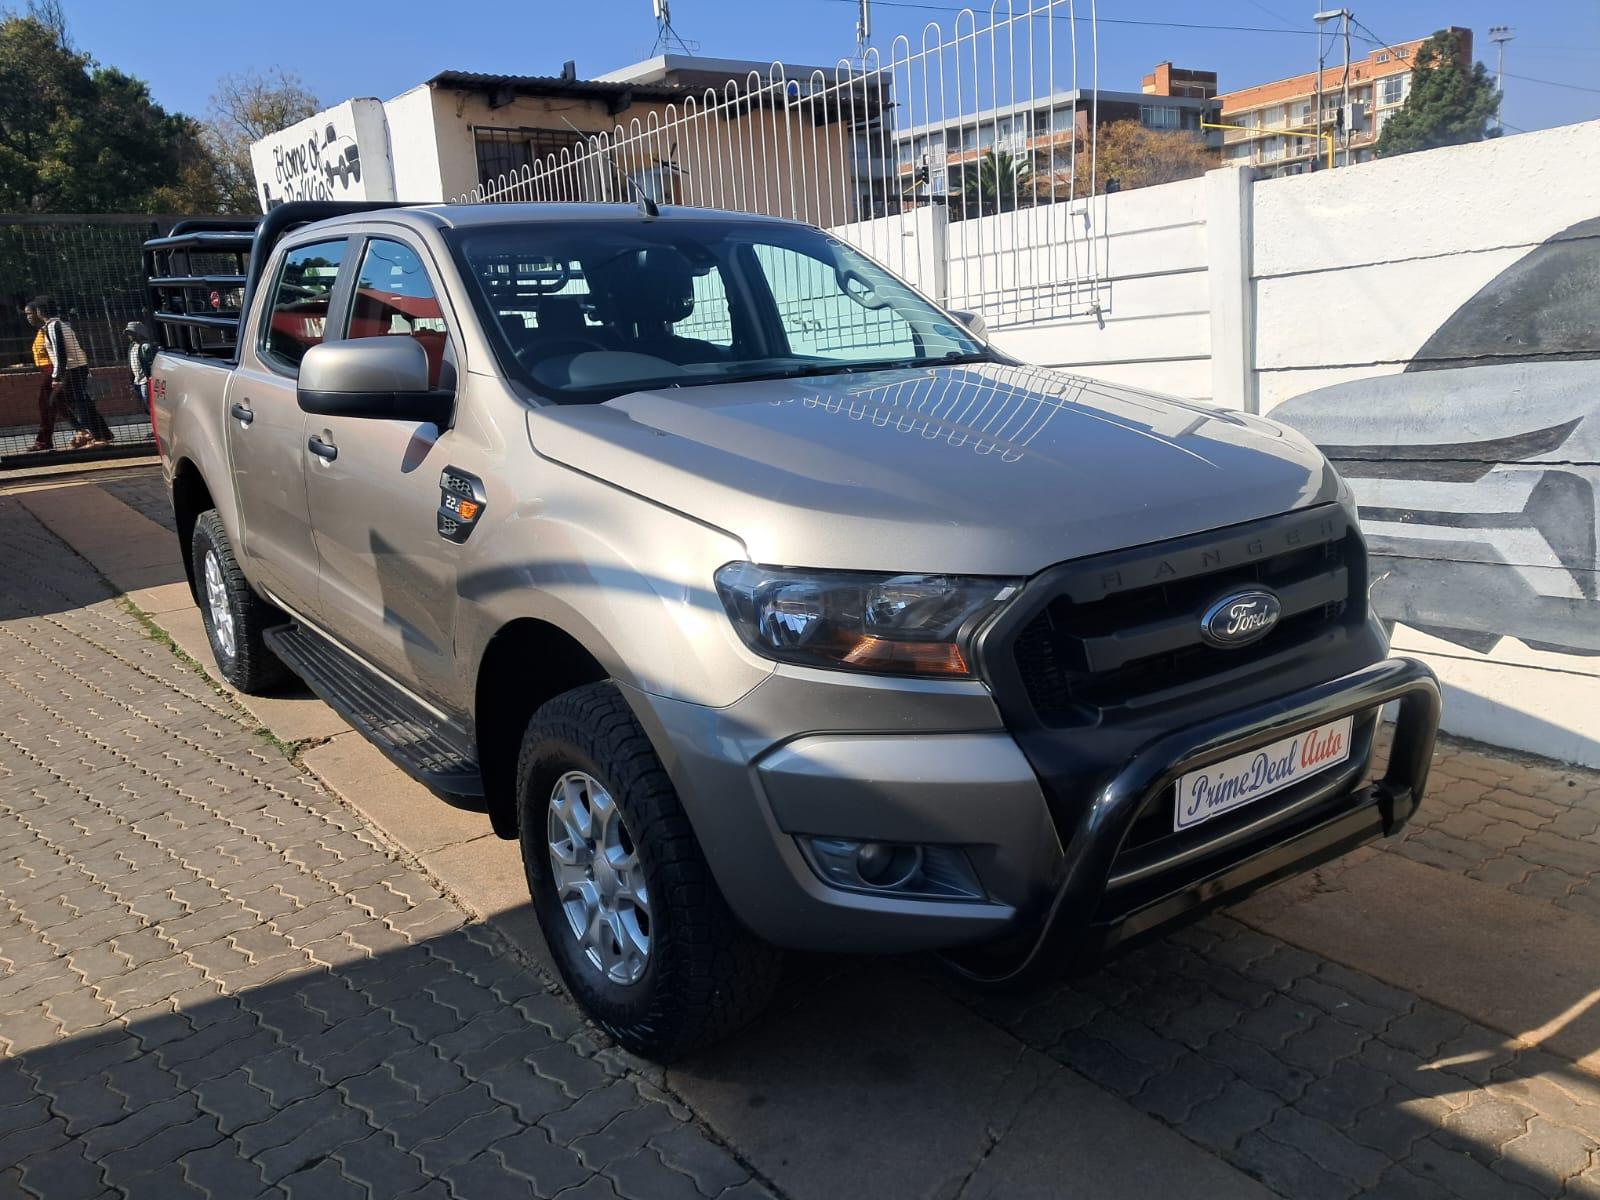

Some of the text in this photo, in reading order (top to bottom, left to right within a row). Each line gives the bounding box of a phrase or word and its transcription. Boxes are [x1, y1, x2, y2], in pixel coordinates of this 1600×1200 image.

[273, 129, 324, 184] Home of
[1227, 601, 1278, 635] Ford
[1301, 729, 1342, 769] Auto
